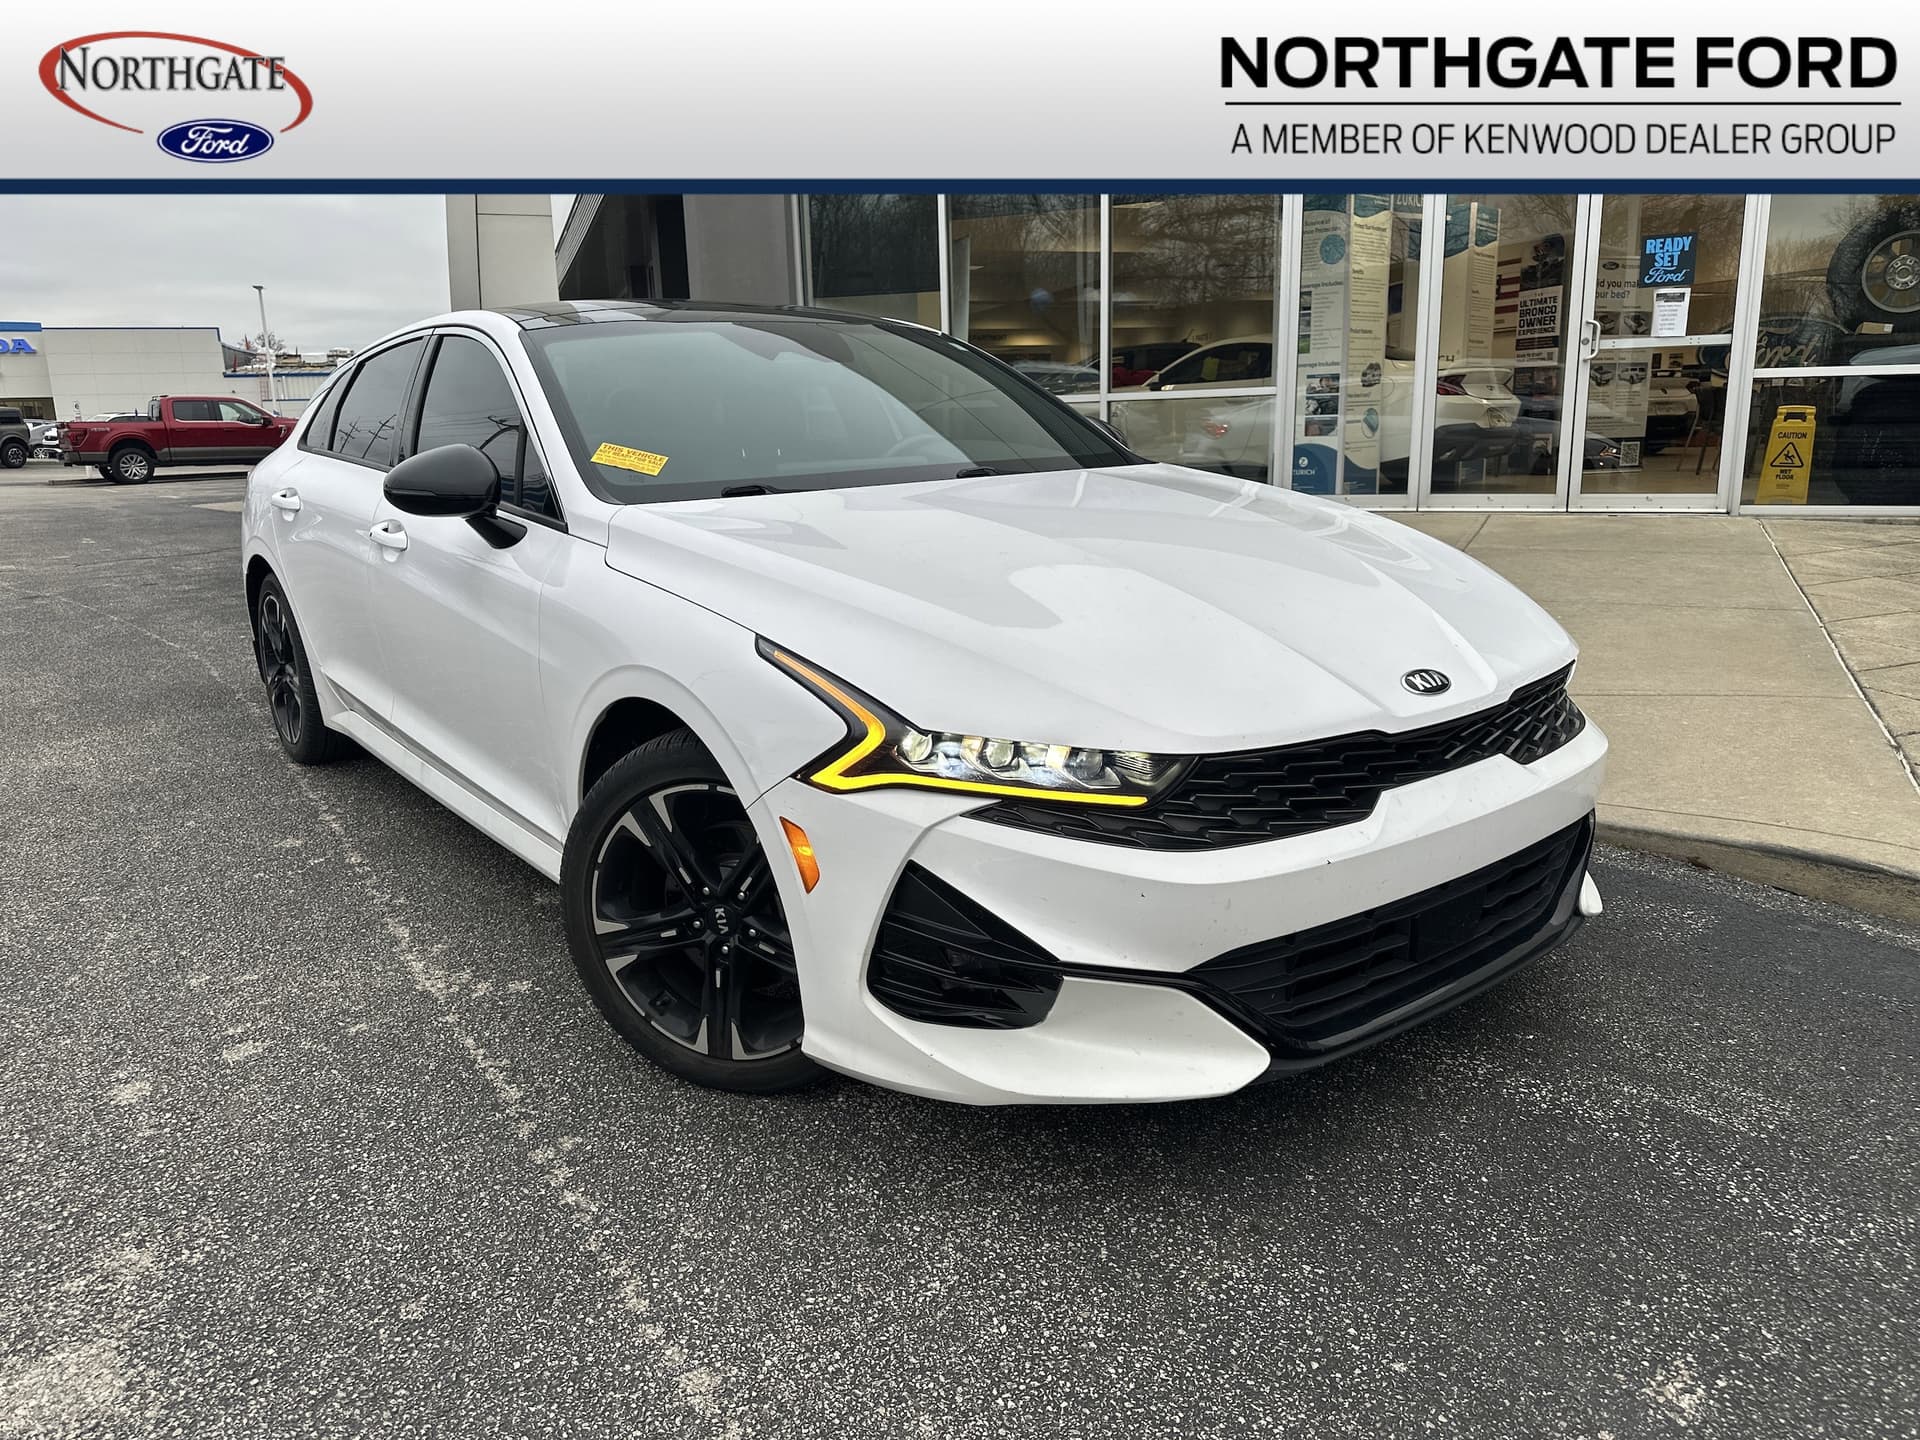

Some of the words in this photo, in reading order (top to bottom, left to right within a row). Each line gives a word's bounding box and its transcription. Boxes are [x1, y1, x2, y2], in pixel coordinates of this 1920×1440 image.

[1646, 236, 1693, 254] READY
[1654, 252, 1681, 267] SET
[1644, 267, 1690, 284] Ford
[1519, 296, 1558, 309] ULTIMATE
[1519, 305, 1558, 319] BRONCO
[1518, 316, 1556, 329] OWNER
[1777, 431, 1808, 440] CAUTION
[603, 445, 624, 453] THIS
[627, 450, 666, 462] VEHICLE
[1406, 671, 1449, 691] KIA
[714, 907, 729, 935] KIA
